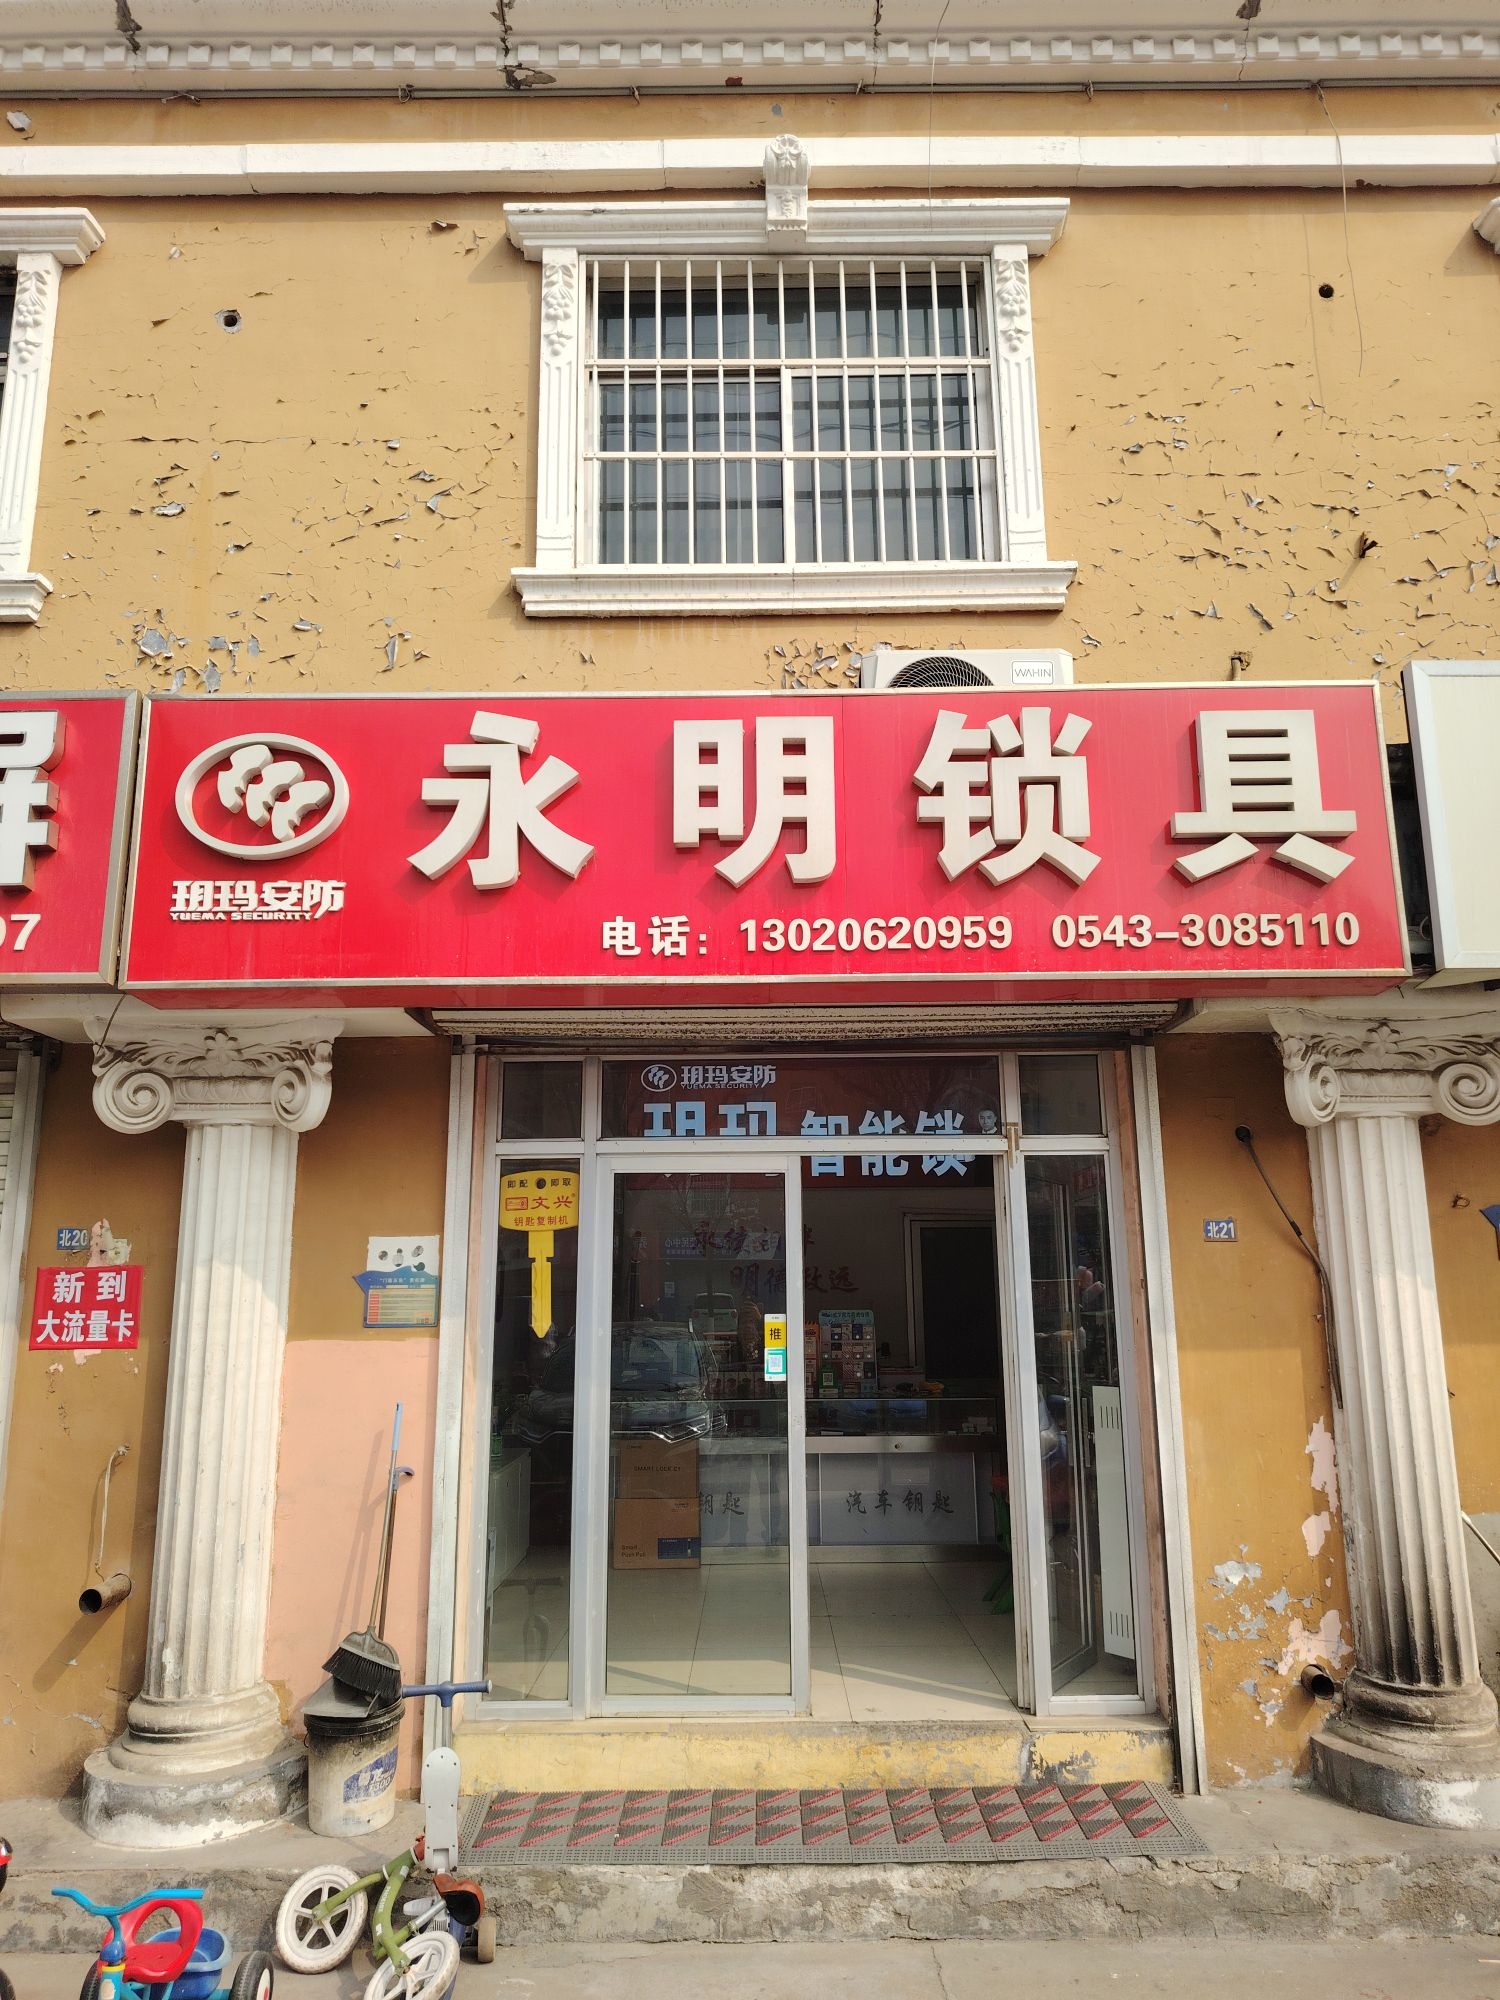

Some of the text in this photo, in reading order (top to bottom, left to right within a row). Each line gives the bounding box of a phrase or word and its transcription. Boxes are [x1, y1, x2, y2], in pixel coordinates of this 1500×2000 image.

[1014, 668, 1051, 678] WAHIN
[407, 704, 1357, 891] 永明锁具
[170, 880, 346, 919] 玥玛安防
[170, 911, 313, 921] YUEMA SECURITY
[0, 914, 41, 951] 7
[743, 915, 1013, 952] 13020620959
[1051, 912, 1360, 948] 0543-3085110
[680, 1065, 776, 1088] 玥玛安防
[800, 1109, 976, 1177] 智能锁
[530, 1195, 573, 1210] 文兴
[513, 1215, 569, 1227] 钥匙复制机
[1207, 1221, 1235, 1239] 北21
[59, 1229, 88, 1247] 北20
[37, 1309, 135, 1344] 大流量卡
[769, 1327, 782, 1341] 推
[846, 1489, 954, 1517] 汽车钥匙
